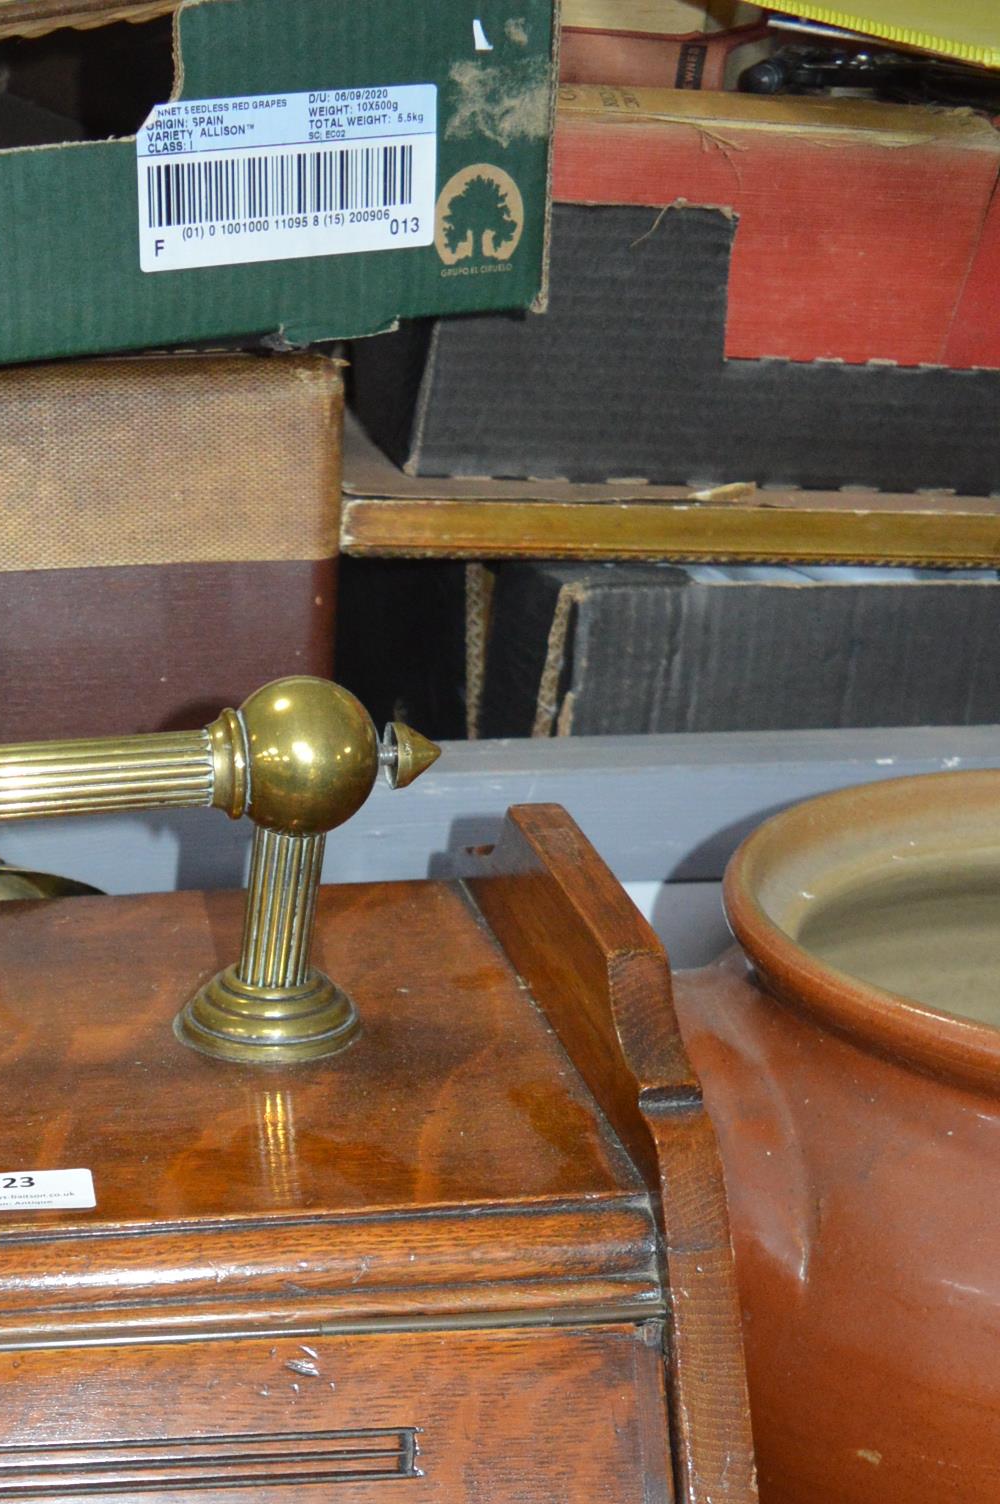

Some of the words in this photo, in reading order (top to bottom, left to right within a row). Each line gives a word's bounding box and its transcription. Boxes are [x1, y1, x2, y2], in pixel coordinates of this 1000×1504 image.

[308, 93, 330, 104] D/U:
[334, 89, 388, 102] 06/09/2020
[184, 104, 229, 115] SEEDLESS
[232, 101, 249, 111] RED
[252, 99, 287, 110] GRAPES
[308, 105, 353, 117] WEIGHT:
[357, 101, 398, 112] 10X500g
[192, 115, 224, 127] SPAIN
[308, 118, 343, 129] TOTAL
[346, 114, 391, 127] WEIGHT:
[397, 112, 424, 124] 5.5kg
[147, 141, 187, 153] CLASS:
[182, 226, 205, 242] (01)
[209, 224, 216, 237] 0
[221, 220, 270, 235] 1001000
[274, 216, 308, 230] 11095
[312, 215, 319, 227] 8
[323, 212, 345, 228] (15)
[349, 208, 390, 224] 200906
[390, 217, 420, 235] 013
[154, 239, 165, 257] F
